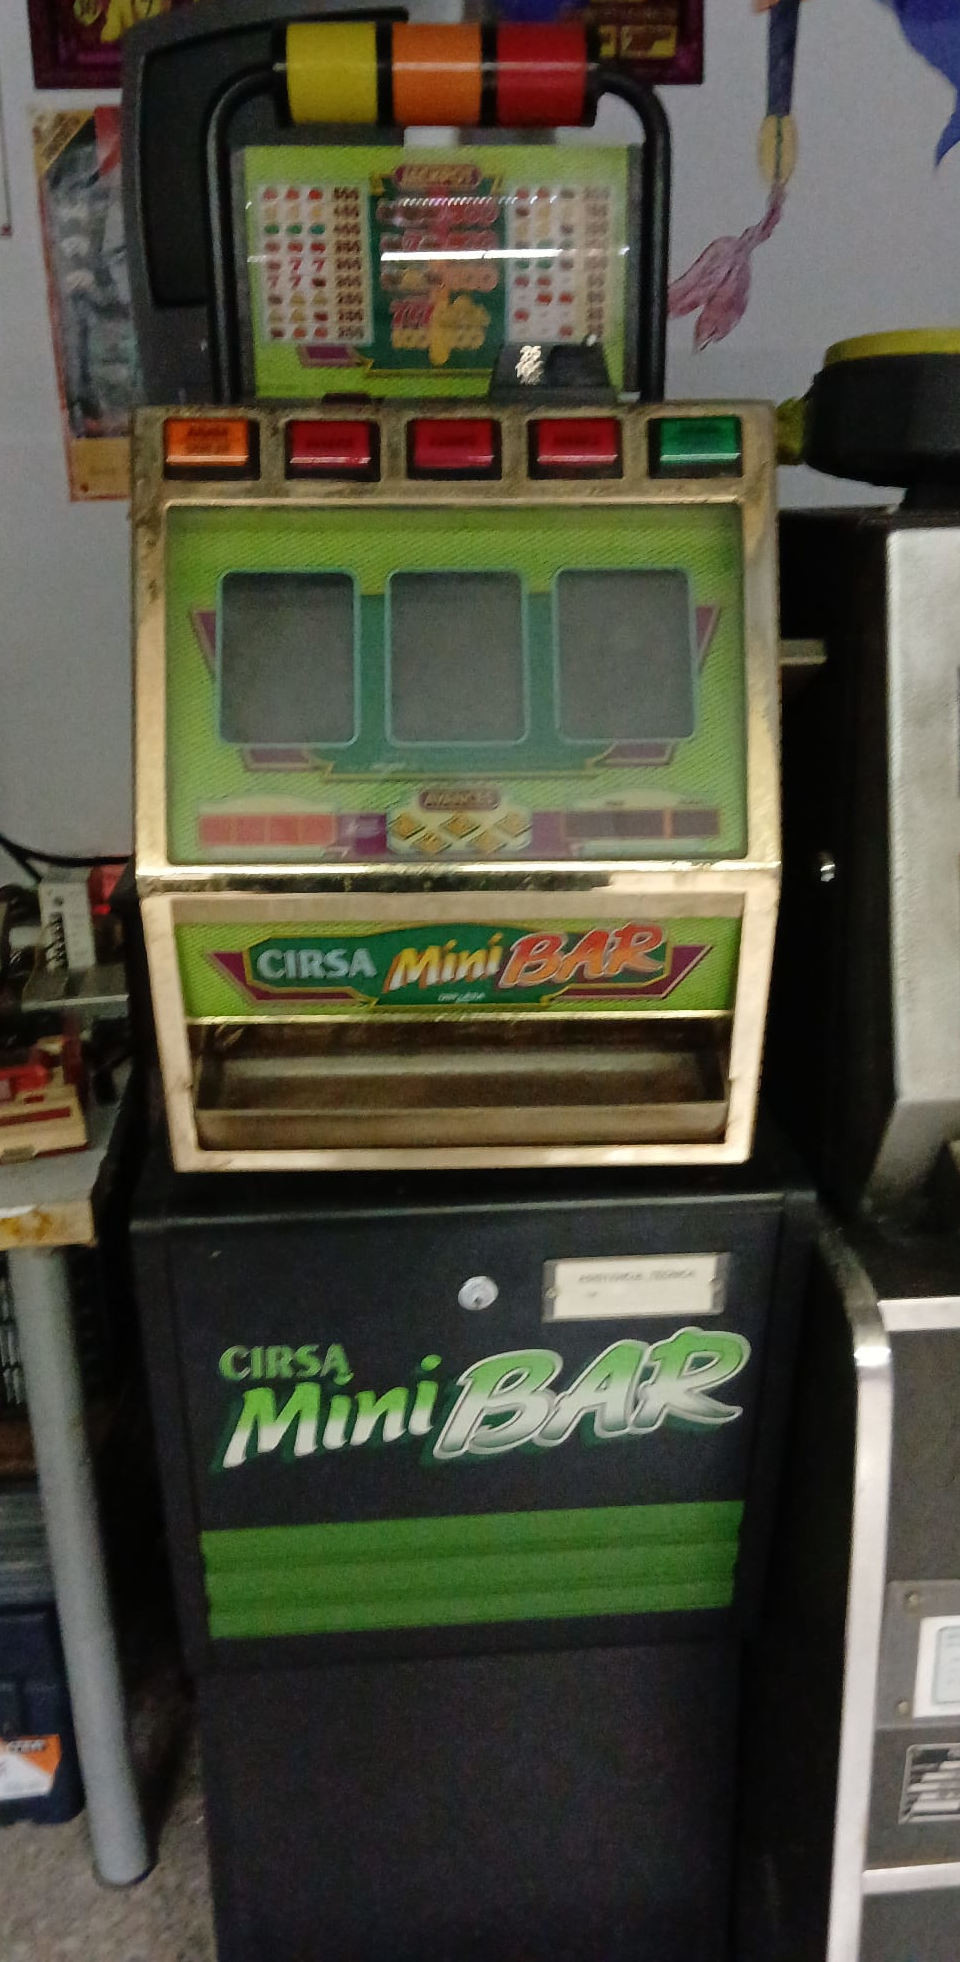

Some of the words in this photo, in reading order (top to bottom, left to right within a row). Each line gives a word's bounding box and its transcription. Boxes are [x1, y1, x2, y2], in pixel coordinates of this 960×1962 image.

[255, 948, 377, 980] CIRSA
[385, 932, 502, 993] Mini
[499, 921, 670, 989] BAR
[218, 1343, 352, 1382] CIRSA
[221, 1353, 442, 1468] Mini
[433, 1326, 751, 1460] BAR
